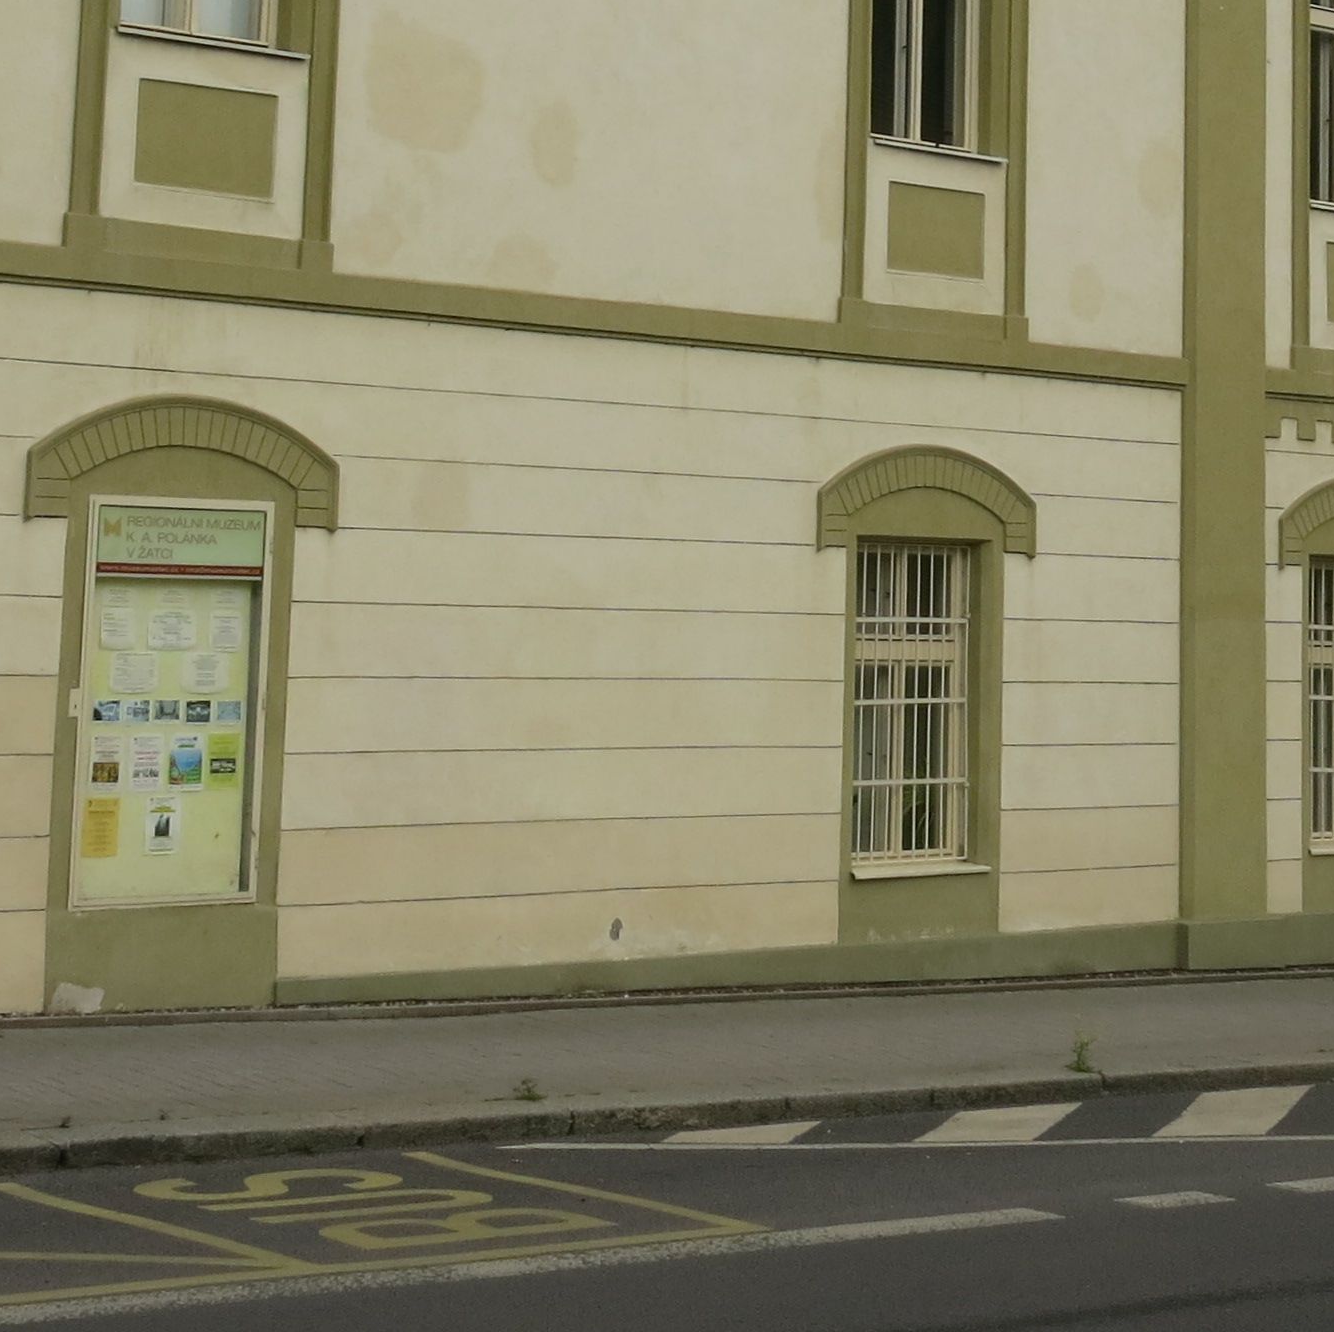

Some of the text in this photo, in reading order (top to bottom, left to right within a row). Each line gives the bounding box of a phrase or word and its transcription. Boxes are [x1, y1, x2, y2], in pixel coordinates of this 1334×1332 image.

[206, 518, 261, 531] MUZEUM
[157, 532, 217, 545] POLÁNKA
[126, 546, 173, 559] V ŽATCI
[132, 1167, 619, 1250] BUS
